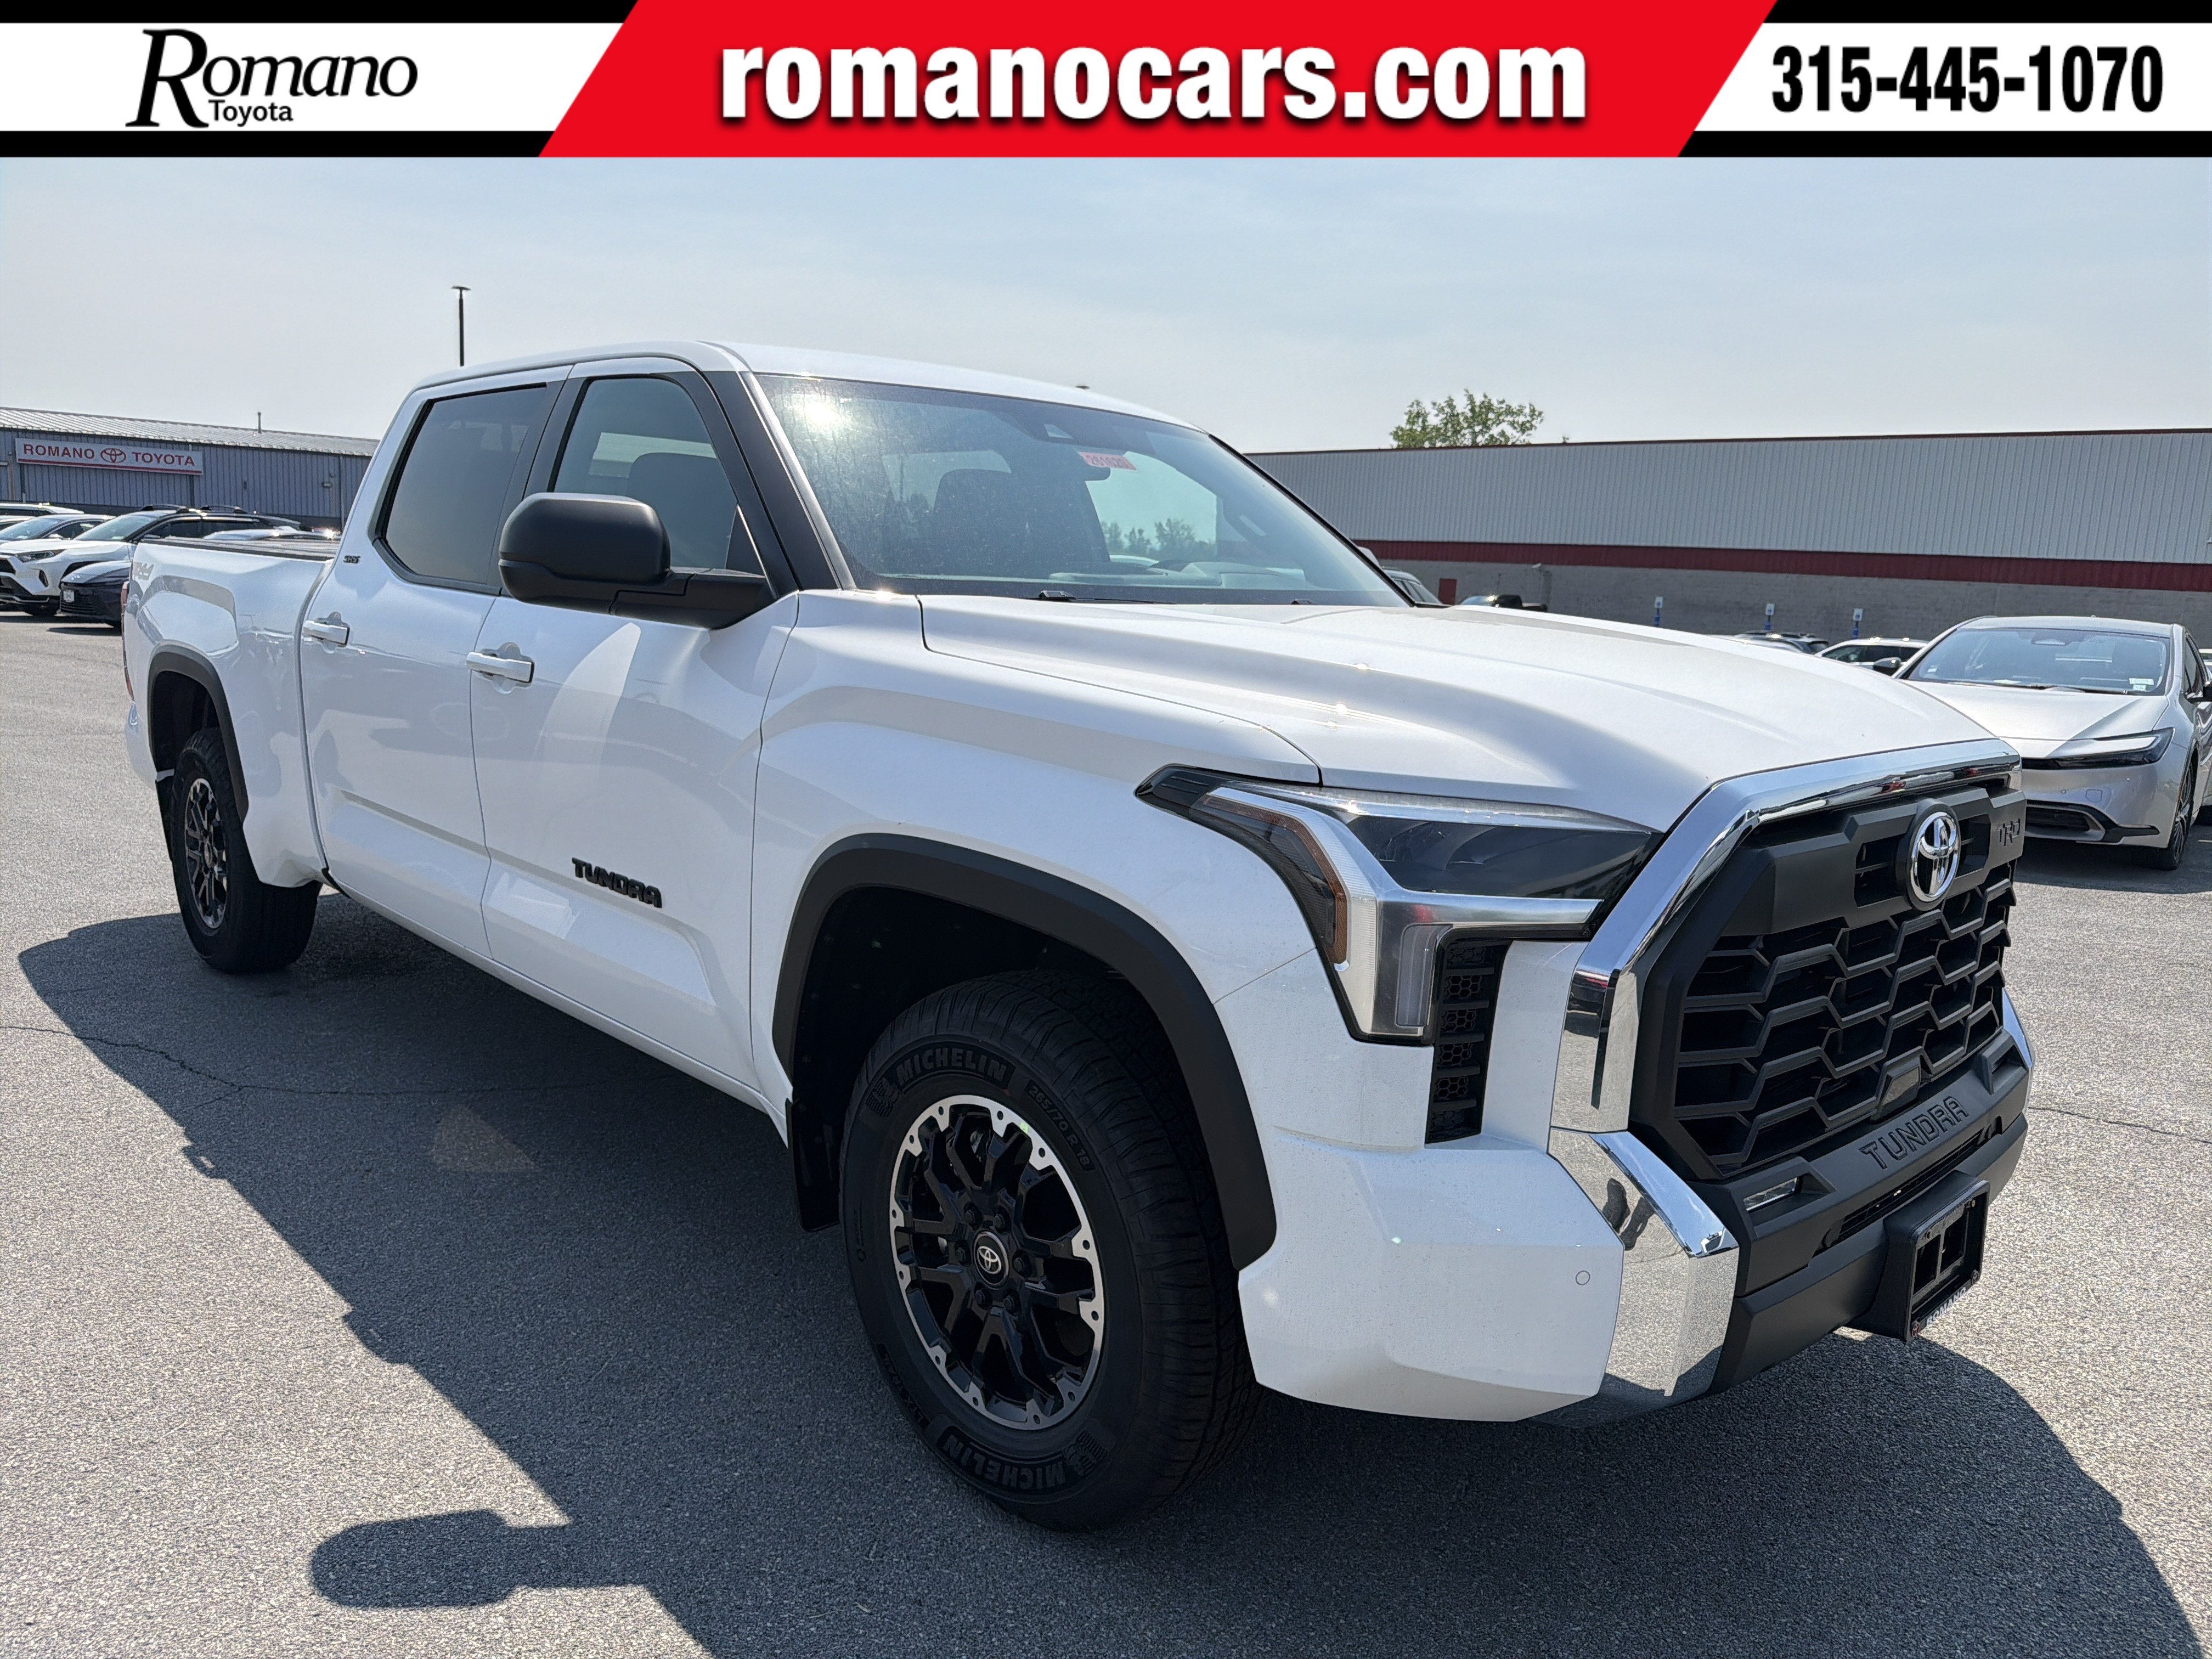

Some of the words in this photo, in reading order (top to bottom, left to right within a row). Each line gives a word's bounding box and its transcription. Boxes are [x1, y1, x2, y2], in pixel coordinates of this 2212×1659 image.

[23, 443, 95, 460] ROMANO
[132, 451, 195, 467] TOYOTA
[571, 856, 663, 909] TUNDRA
[895, 1046, 1007, 1088] MICHELIN
[1858, 1096, 1969, 1170] TUNDRA
[1926, 1286, 1966, 1327] ROMANO
[943, 1434, 1066, 1491] MICHELIN
